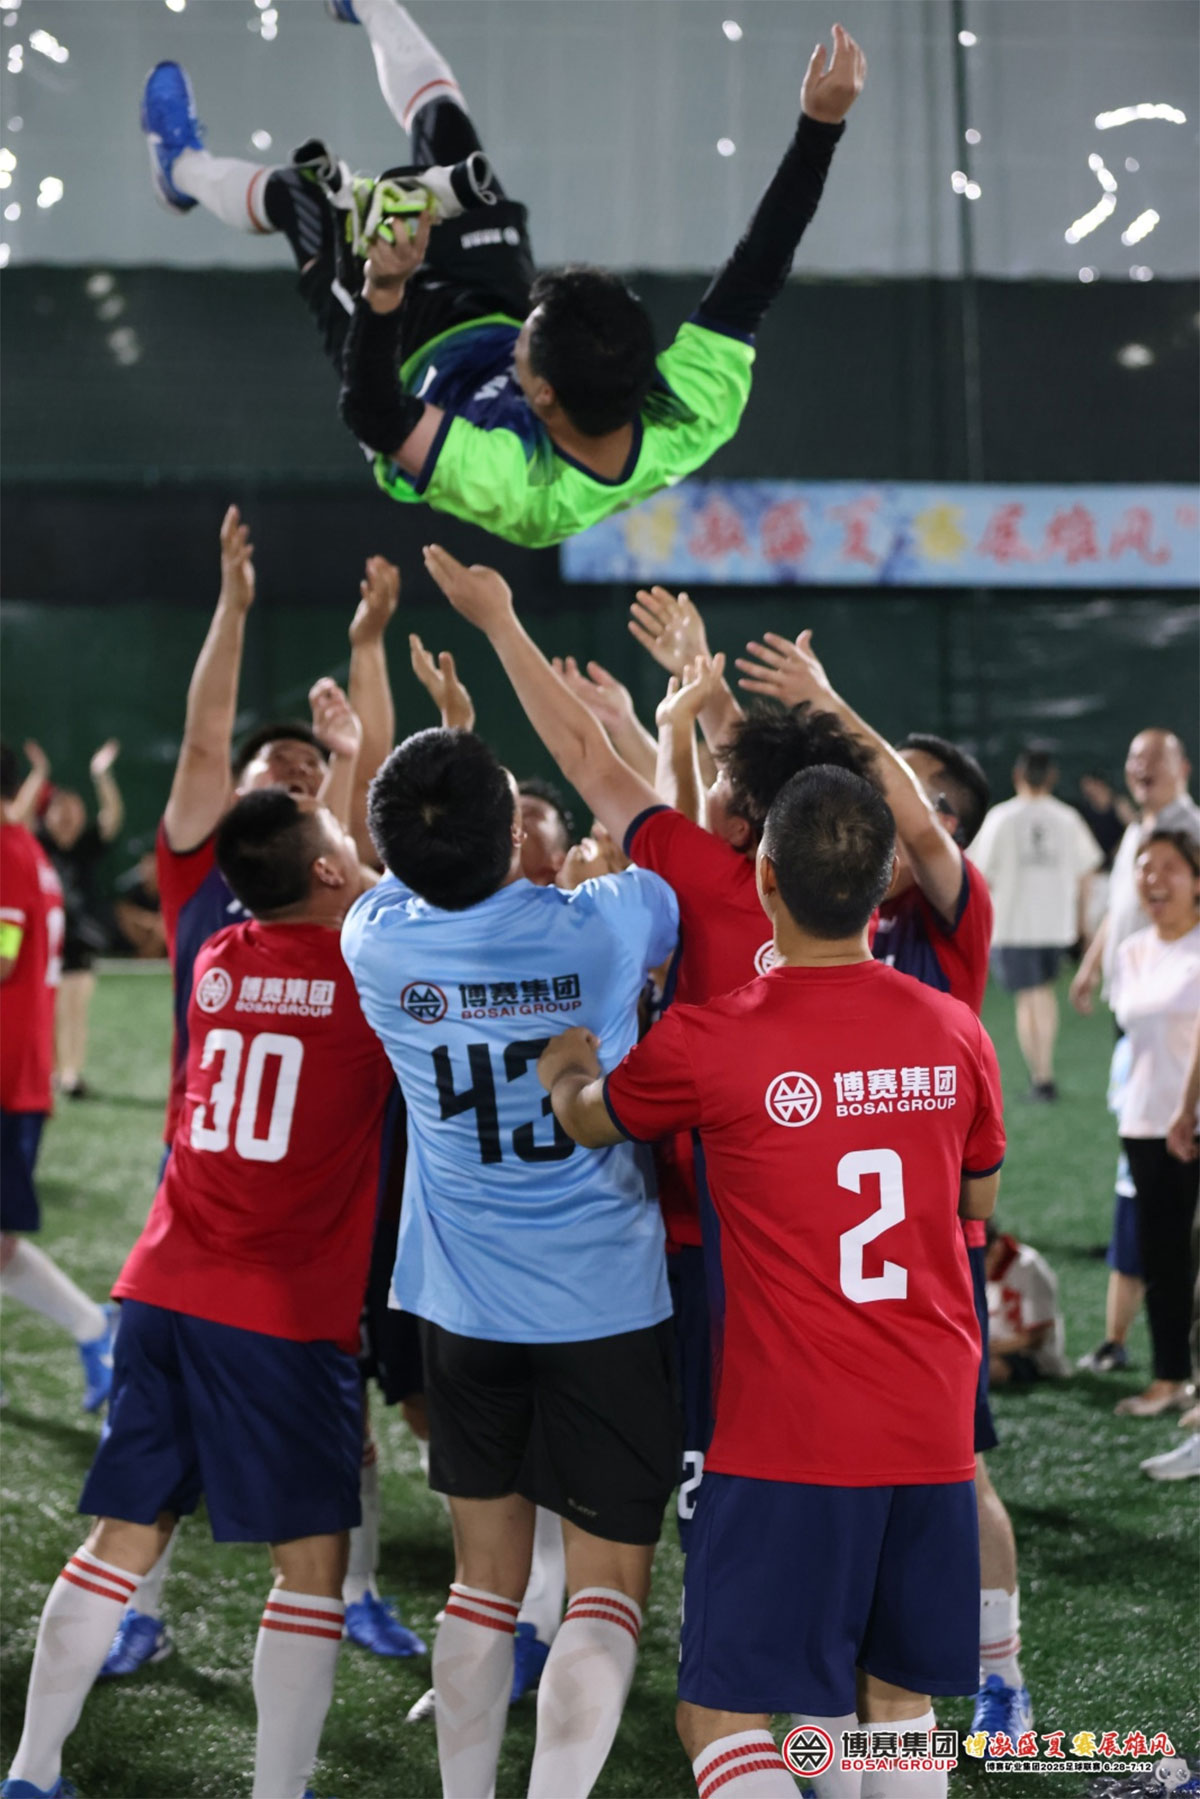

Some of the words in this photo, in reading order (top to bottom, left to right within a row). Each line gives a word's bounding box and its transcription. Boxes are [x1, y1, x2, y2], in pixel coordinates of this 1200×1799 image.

[458, 973, 580, 1008] 博赛集团
[461, 1006, 516, 1019] BOSAI
[519, 1000, 582, 1015] GROUP
[277, 1003, 333, 1017] GROUP
[190, 1028, 304, 1163] 30
[431, 1038, 576, 1164] 43
[833, 1065, 957, 1103] 博赛集团
[836, 1101, 894, 1117] BOSAI
[897, 1097, 957, 1112] GROUP
[837, 1148, 908, 1304] 2
[677, 1451, 704, 1519] 2
